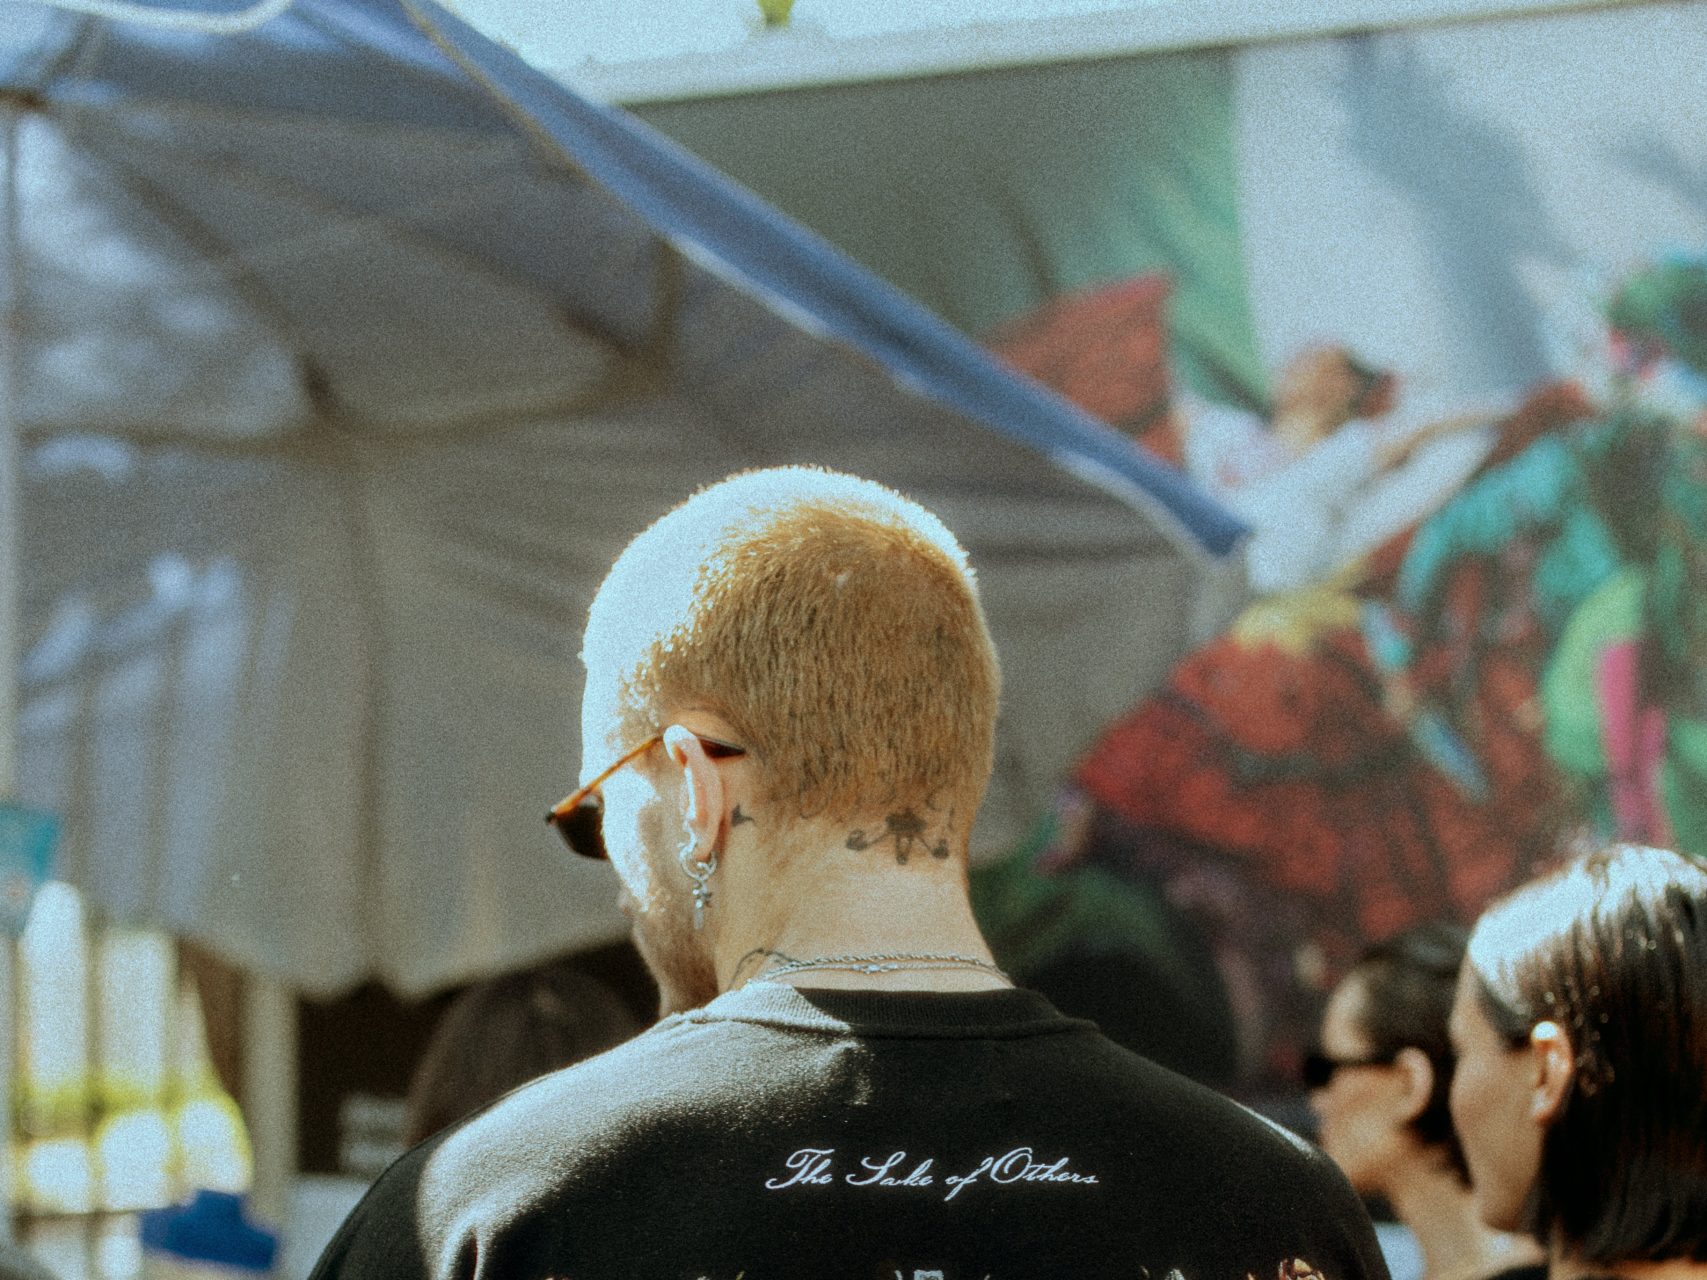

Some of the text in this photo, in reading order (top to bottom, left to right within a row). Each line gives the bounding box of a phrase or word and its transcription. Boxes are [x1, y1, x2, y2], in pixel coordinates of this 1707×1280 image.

[765, 1147, 1100, 1202] The Sake of Others
